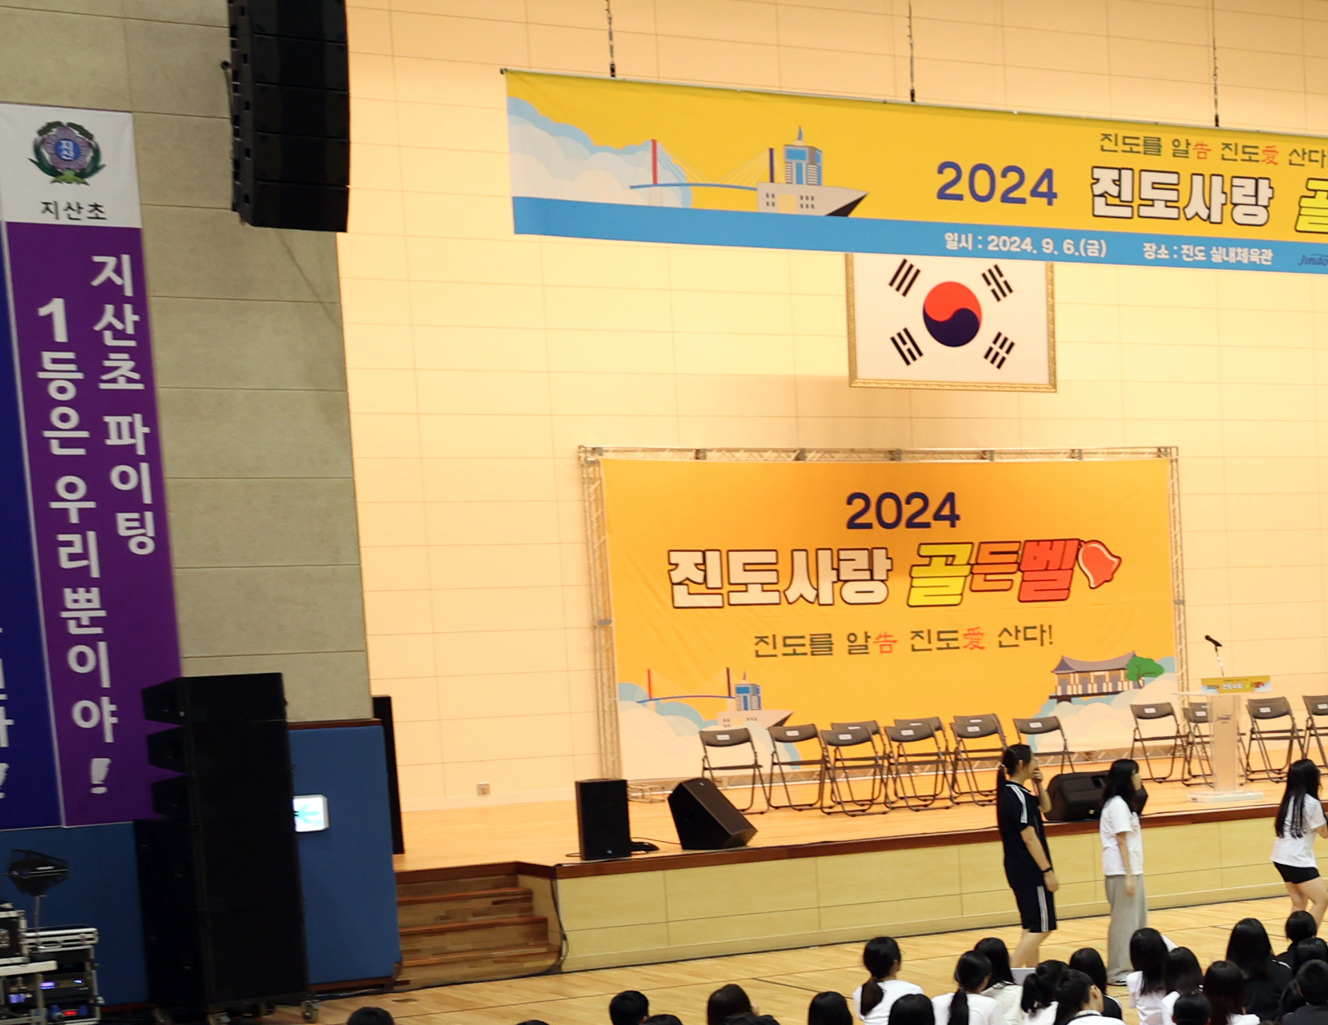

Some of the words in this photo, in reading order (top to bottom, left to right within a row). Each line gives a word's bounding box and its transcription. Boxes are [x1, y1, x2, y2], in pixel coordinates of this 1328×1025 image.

[1100, 132, 1162, 158] 진도를
[41, 200, 107, 221] 지산초
[937, 161, 1058, 207] 2024
[1091, 166, 1273, 227] 진도사랑
[944, 232, 973, 251] 일시
[987, 234, 1037, 254] 2024.
[1043, 237, 1059, 256] 9.
[1063, 237, 1107, 259] 6.(금)
[1143, 242, 1170, 262] 장소
[1181, 243, 1206, 262] 진도
[1210, 243, 1273, 265] 실내체육관
[90, 254, 145, 390] 지산초
[37, 298, 90, 456] 1등은
[102, 413, 155, 555] 파이팅
[846, 491, 960, 530] 2024
[667, 547, 893, 609] 진도사랑
[906, 537, 1082, 607] 골든벨
[754, 631, 835, 658] 진도를
[998, 624, 1054, 649] 산다!
